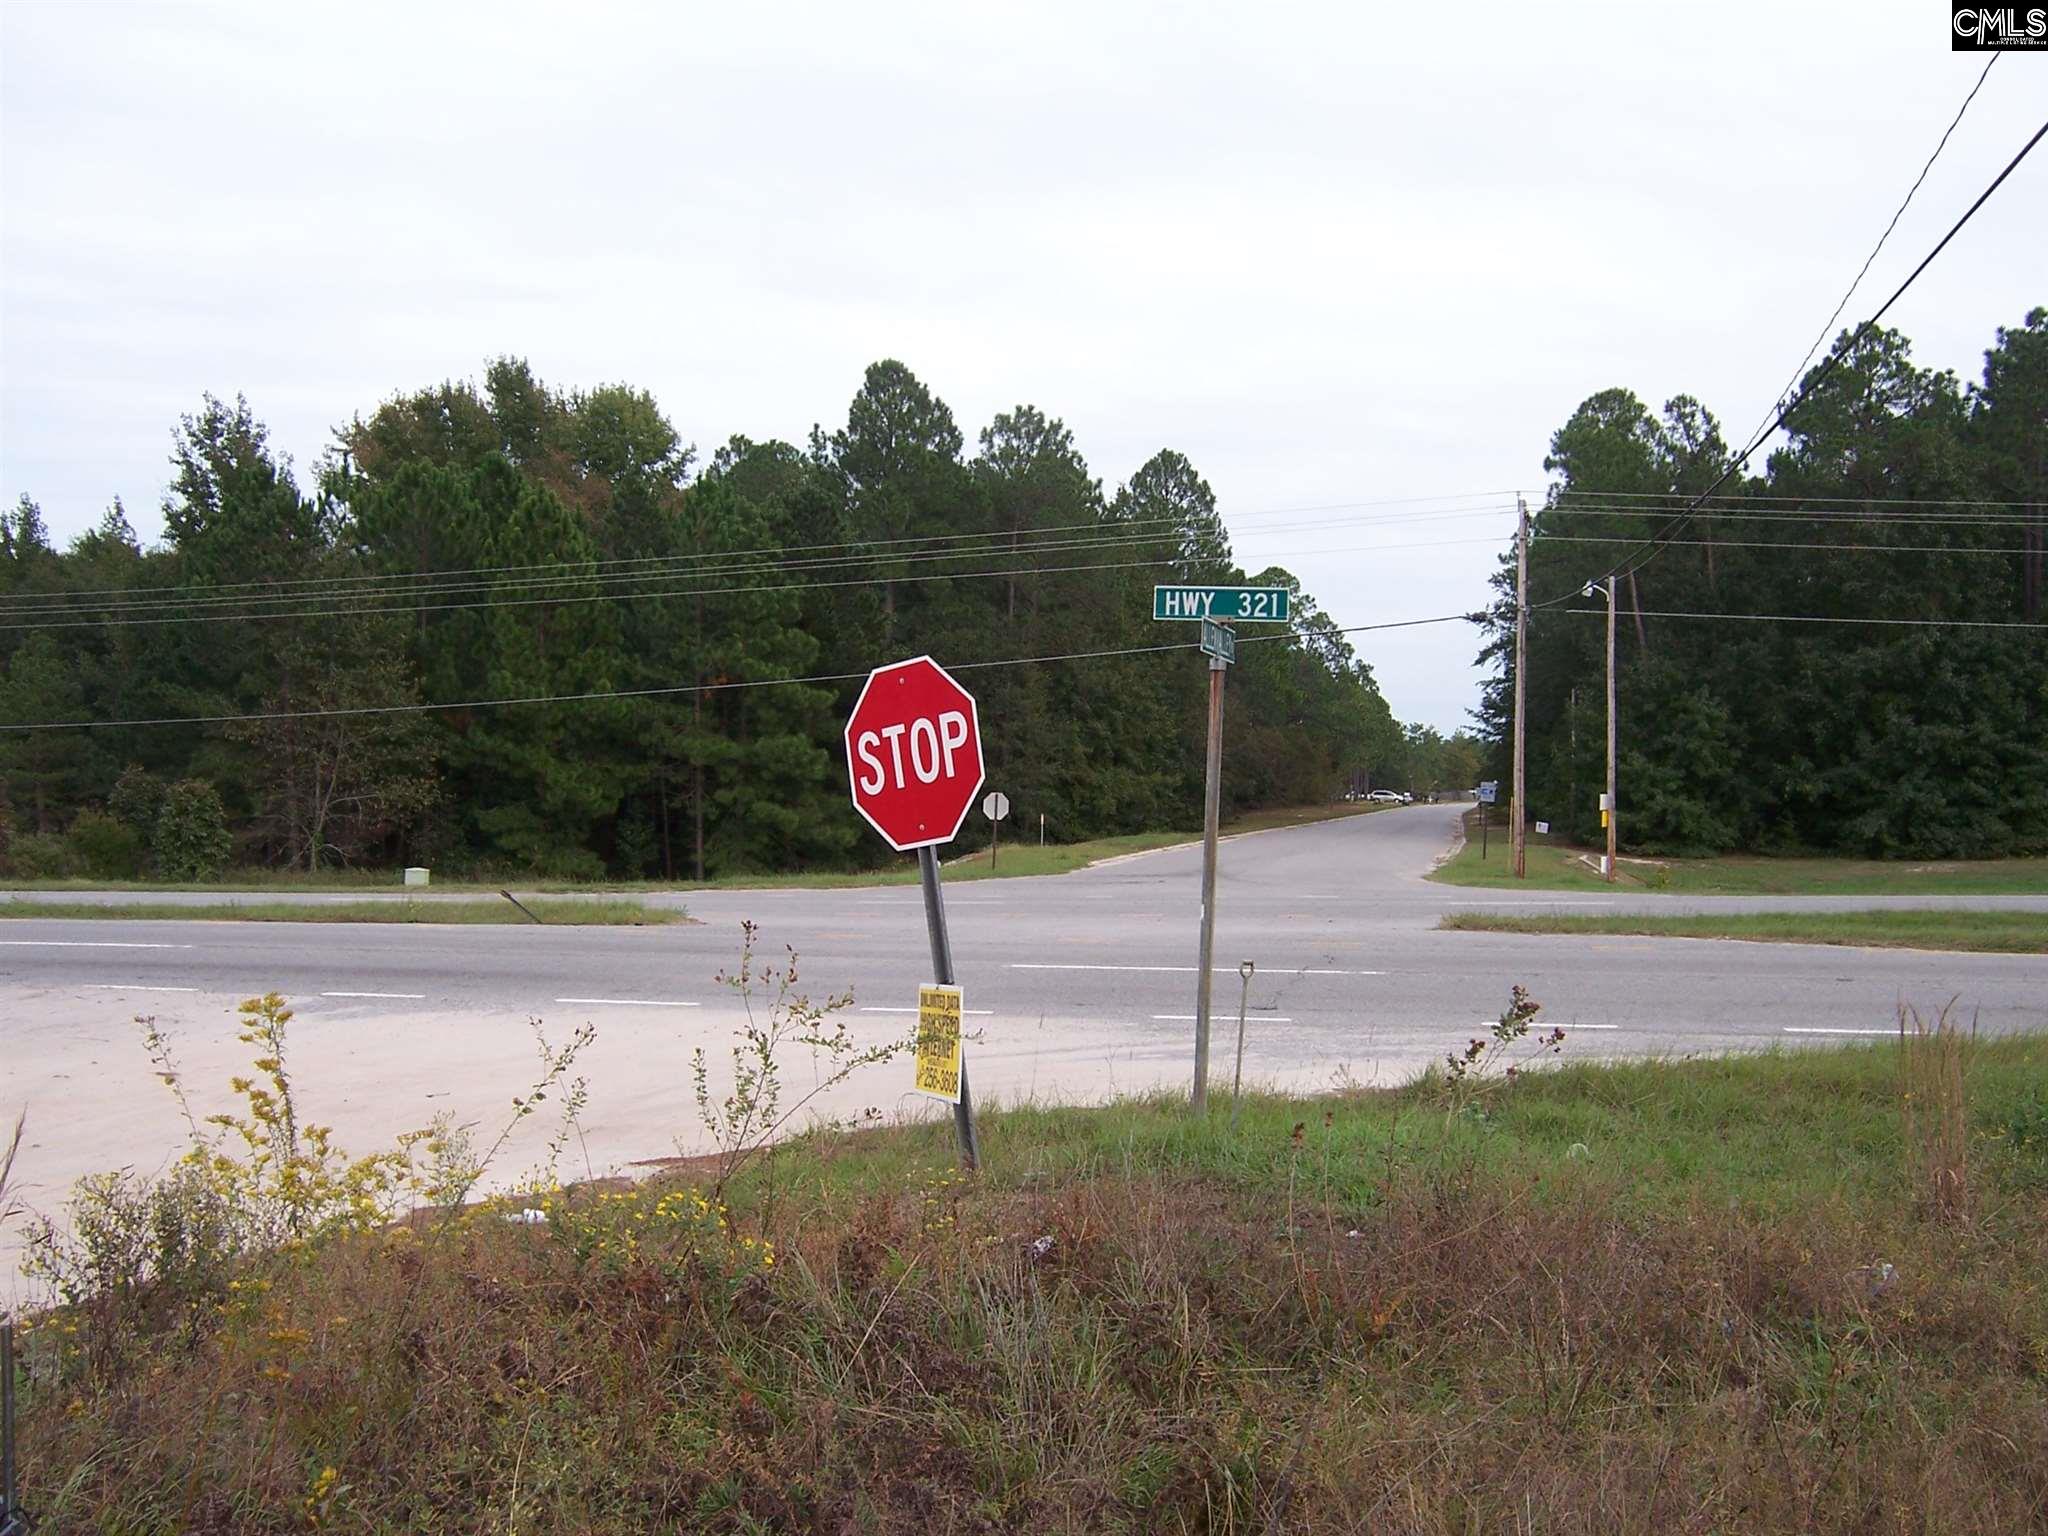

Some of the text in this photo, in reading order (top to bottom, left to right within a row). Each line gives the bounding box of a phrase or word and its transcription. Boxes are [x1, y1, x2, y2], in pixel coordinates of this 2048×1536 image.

[1165, 591, 1278, 617] HWY 321
[858, 710, 968, 796] STOP
